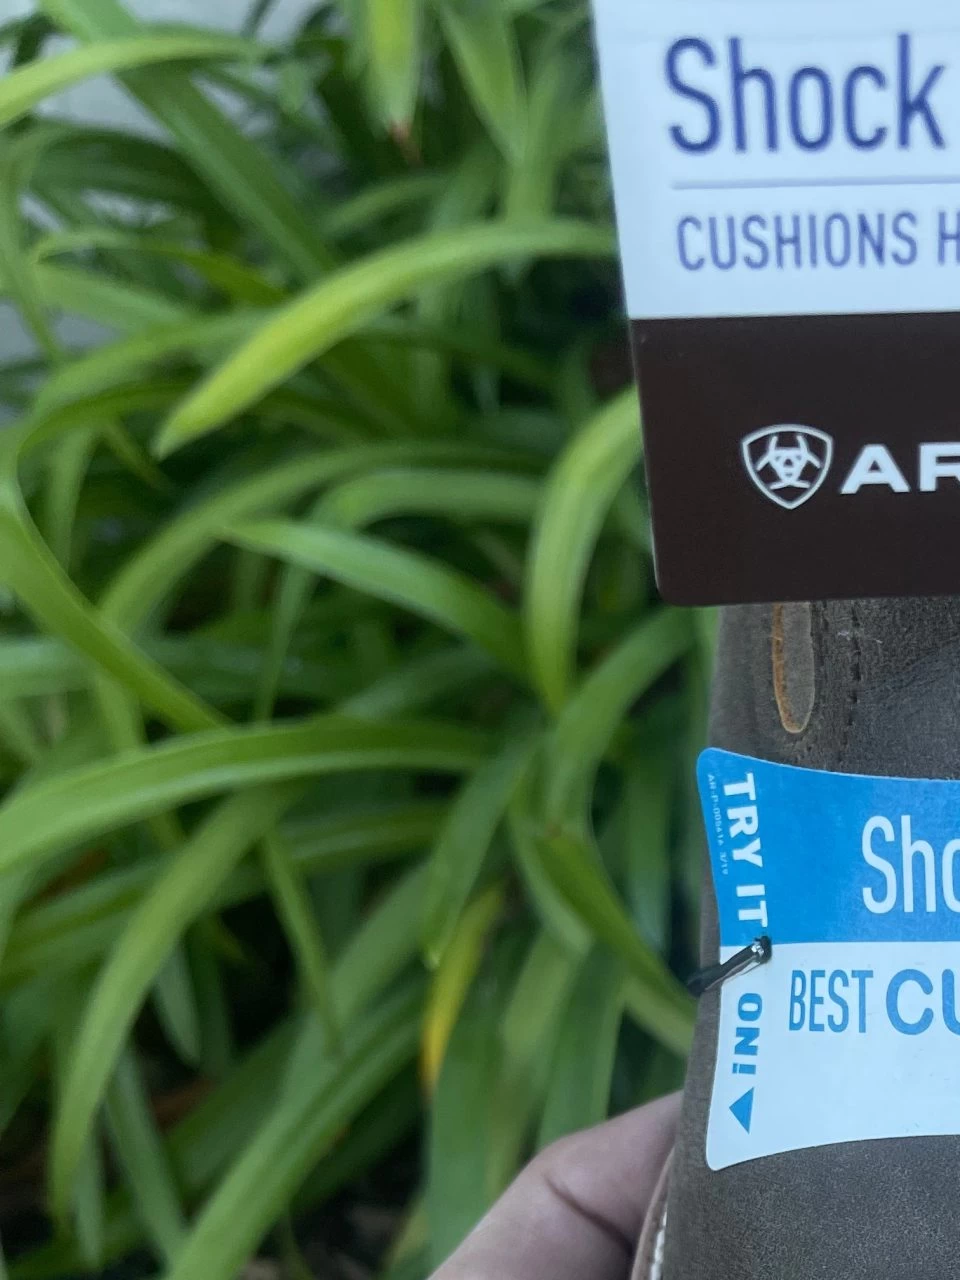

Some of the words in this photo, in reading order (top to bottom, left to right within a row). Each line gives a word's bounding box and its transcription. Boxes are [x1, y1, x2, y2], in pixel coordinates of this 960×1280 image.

[664, 33, 946, 154] Shock
[676, 210, 918, 272] CUSHIONS
[723, 772, 763, 868] TRY
[736, 884, 768, 928] IT
[732, 992, 763, 1075] ON!
[788, 969, 874, 1034] BEST
